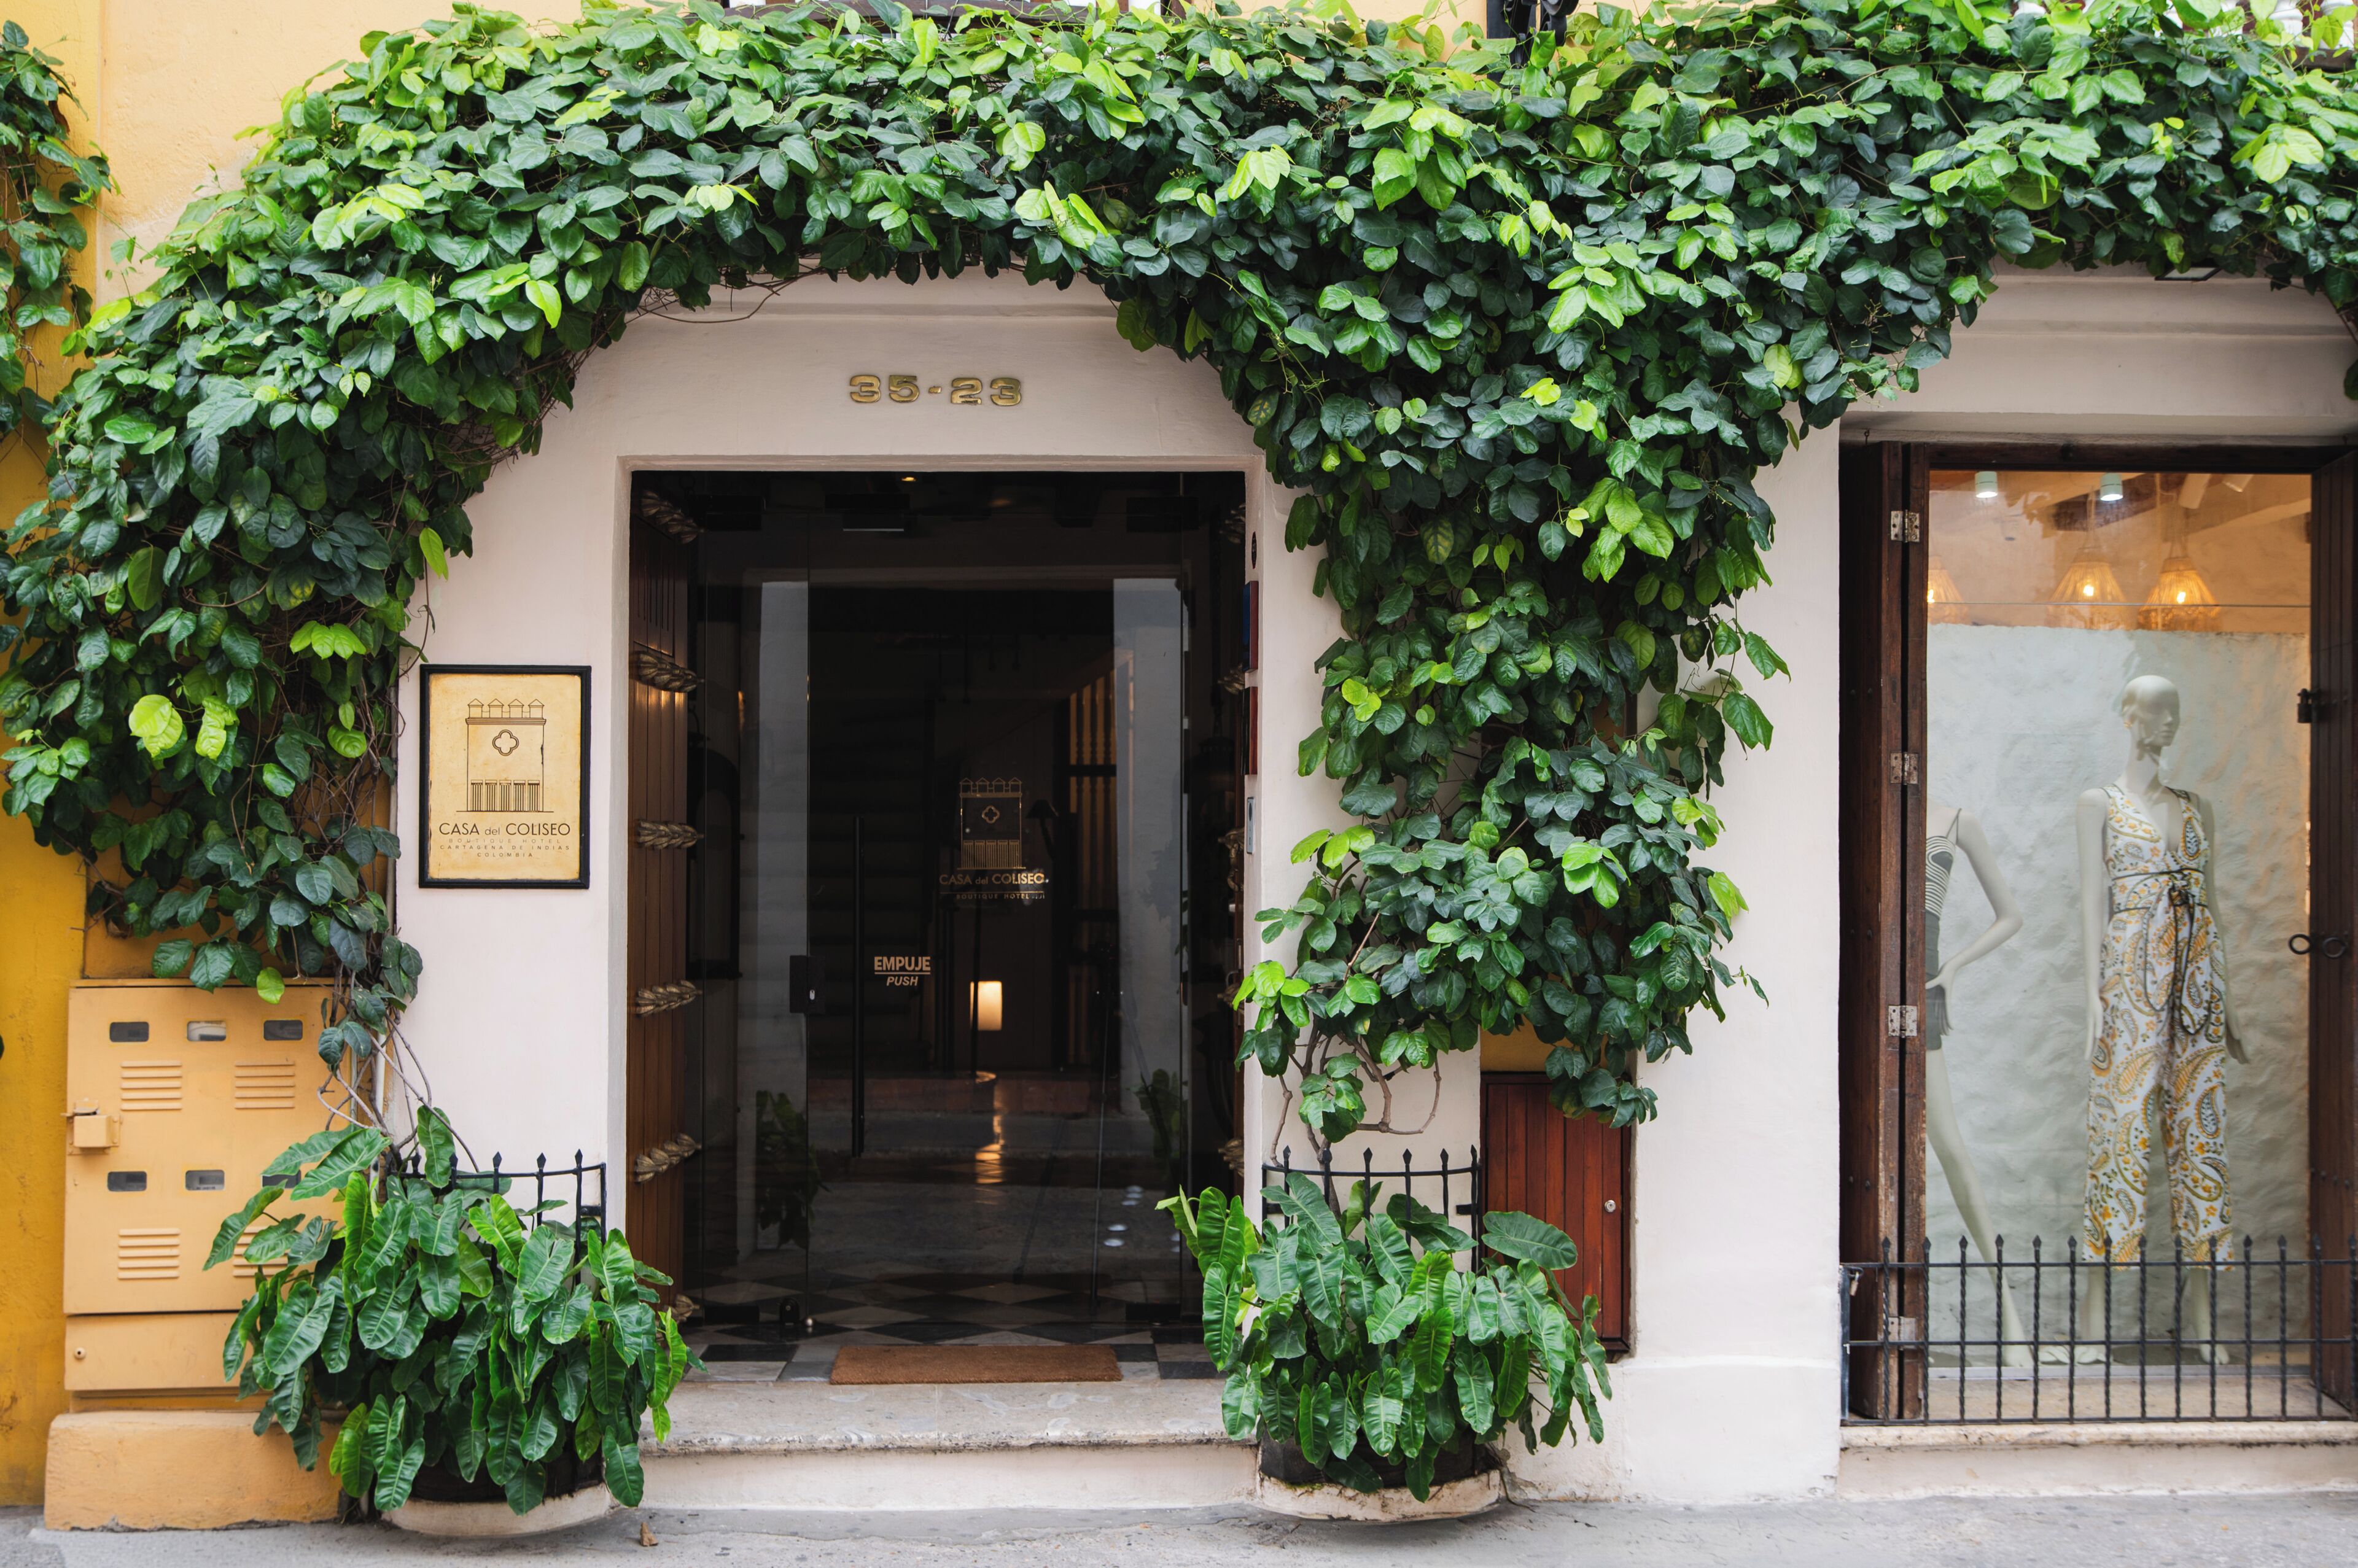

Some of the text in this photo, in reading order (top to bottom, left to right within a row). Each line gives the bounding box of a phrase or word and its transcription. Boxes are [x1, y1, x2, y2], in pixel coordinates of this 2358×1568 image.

[850, 375, 1021, 406] 35-23
[439, 823, 570, 836] CASA del COLISEO
[939, 874, 972, 885] CASA
[992, 873, 1045, 885] COLISEO
[874, 957, 931, 971] EMPUJE
[886, 976, 919, 986] PUSH
